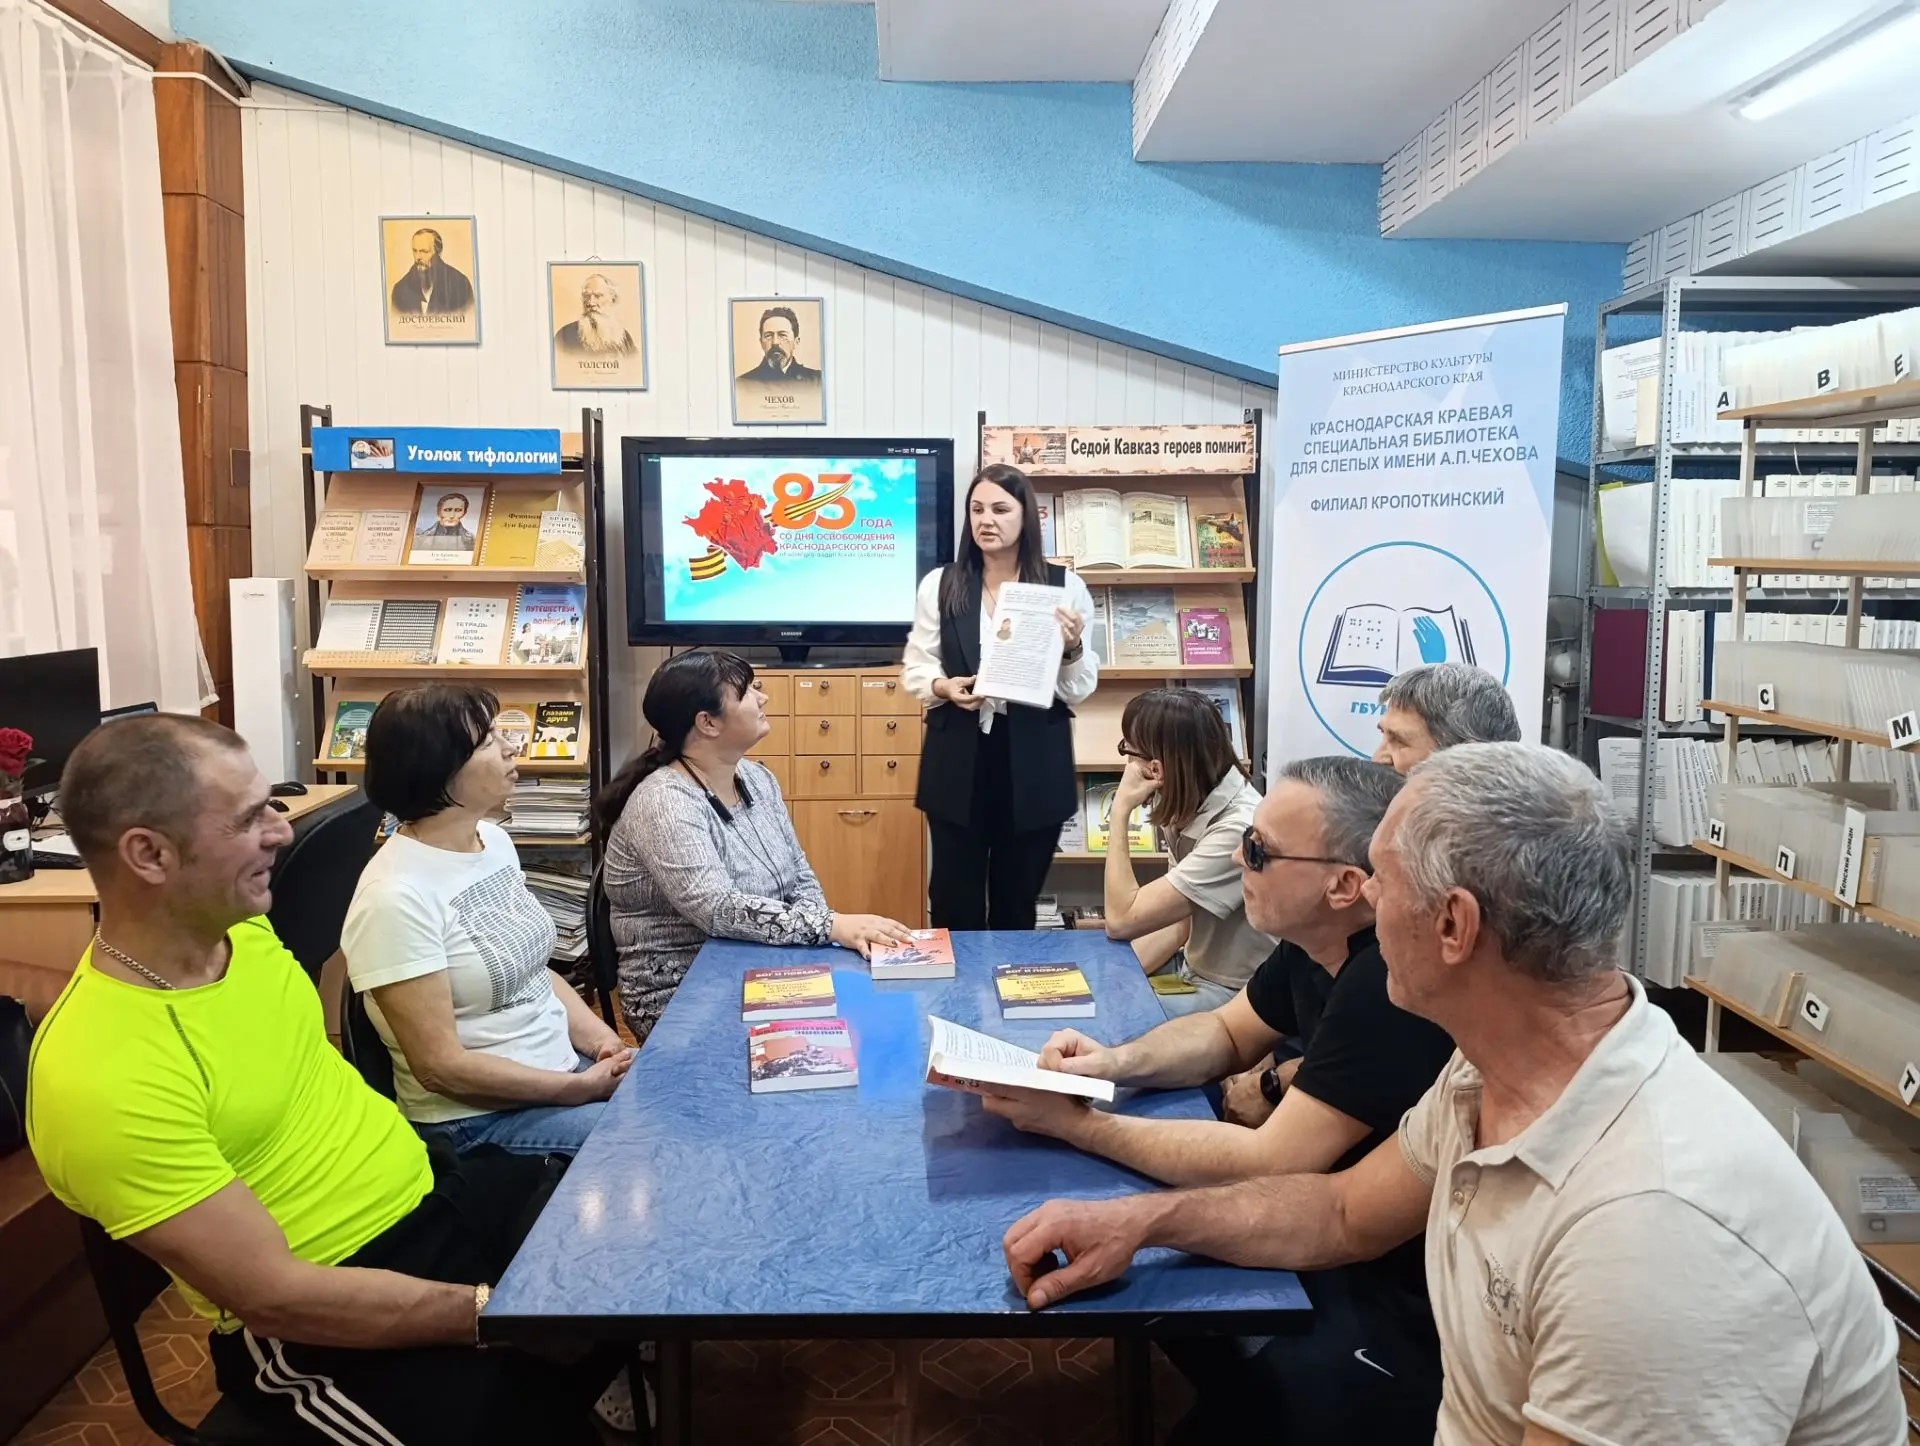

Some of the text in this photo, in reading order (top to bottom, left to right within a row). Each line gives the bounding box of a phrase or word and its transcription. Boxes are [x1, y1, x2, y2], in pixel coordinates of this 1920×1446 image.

[399, 314, 466, 324] ДОСТОЕВСКИЙ
[578, 360, 620, 369] ТОЛСТОЙ
[1333, 352, 1493, 382] МИНИСТЕРСТВО КУЛЬТУРЫ
[1343, 370, 1484, 397] КРАСНОДАРСКОГО КРАЯ
[1817, 369, 1831, 389] В
[765, 395, 795, 404] ЧЕХОВ
[1717, 391, 1730, 409] А
[1310, 404, 1513, 436] КРАСНОДАРСКАЯ КРАЕВАЯ
[1071, 438, 1247, 458] Седой Кавказ героев помнит
[1304, 425, 1519, 455] СПЕЦИАЛЬНАЯ БИБЛИОТЕКА
[407, 445, 558, 467] Уголок тифлологии
[1290, 461, 1317, 478] ДЛЯ
[1321, 455, 1380, 473] СЛЕПЫХ
[1384, 452, 1436, 469] ИМЕНИ
[771, 472, 858, 530] 83
[1311, 488, 1504, 511] ФИЛИАЛ КРОПОТКИНСКИЙ
[860, 518, 893, 528] ГОДА
[780, 543, 895, 551] КРАСНОДАРСКОГО КРАЯ
[795, 533, 814, 541] ДНЯ
[816, 533, 895, 541] ОСВОБОЖДЕНИЯ
[1760, 688, 1770, 705] С
[1892, 715, 1912, 740] М
[1710, 823, 1722, 842] Н
[1778, 851, 1789, 872] П
[1806, 1000, 1820, 1019] С
[1904, 1069, 1916, 1091] Т
